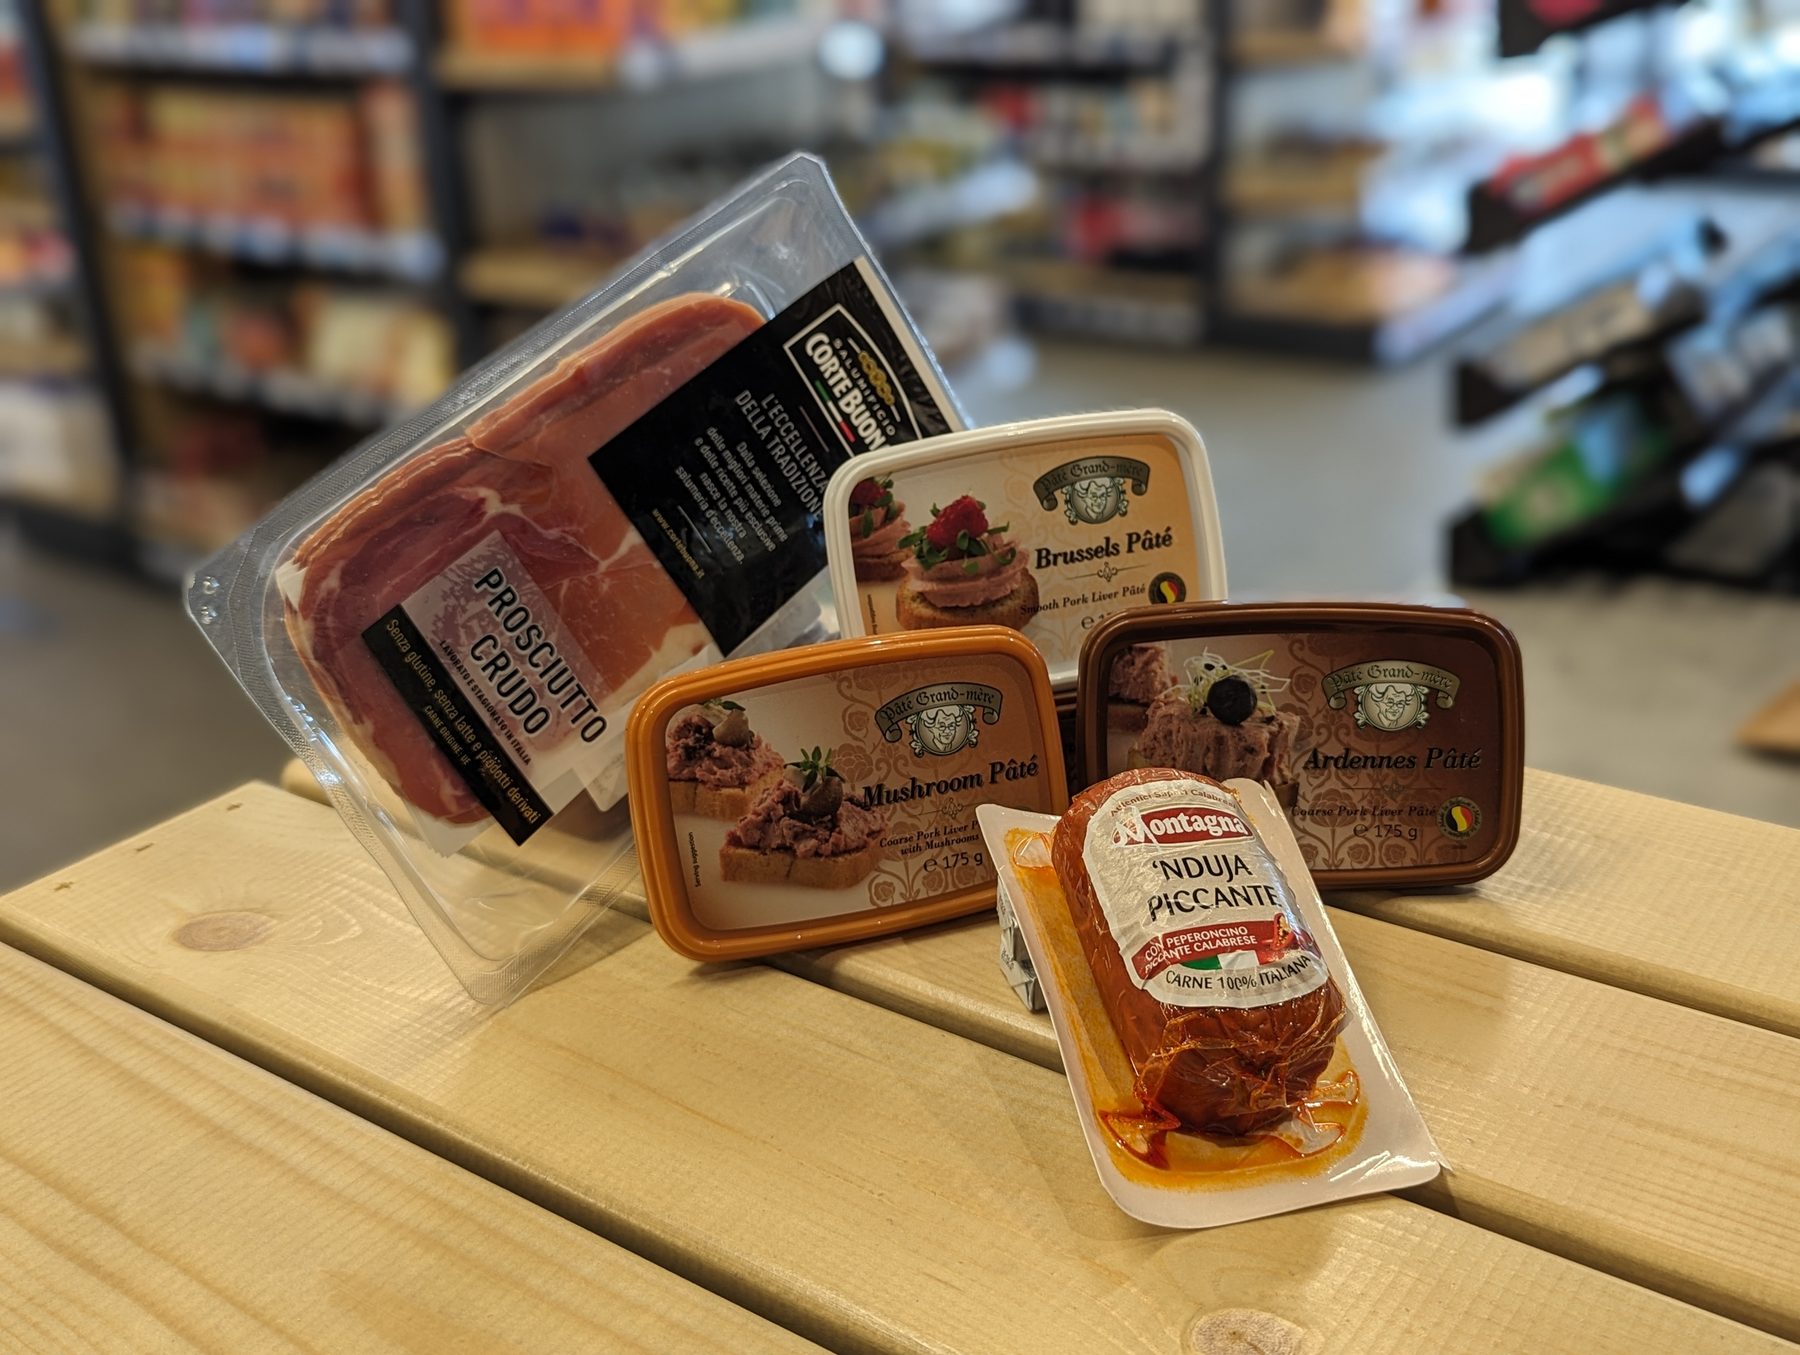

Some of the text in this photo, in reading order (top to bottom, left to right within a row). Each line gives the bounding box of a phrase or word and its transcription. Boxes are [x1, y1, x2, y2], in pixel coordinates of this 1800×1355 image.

[805, 332, 891, 451] CORTEBUON
[833, 338, 896, 436] SALUMIFICIO
[735, 390, 772, 440] DELLA
[676, 465, 709, 511] salumeria
[695, 437, 703, 446] e
[700, 445, 719, 469] delle
[716, 467, 738, 498] ricette
[745, 512, 776, 552] esclusive
[707, 427, 789, 542] delle migliori materie prime
[736, 441, 782, 507] Dalla selezione
[700, 472, 747, 538] nasce la nostra
[1035, 526, 1173, 570] Brussels Pâté
[1020, 599, 1060, 616] Smooth
[1063, 593, 1088, 608] Pork
[1092, 590, 1120, 604] Liver
[1122, 583, 1146, 598] Pâté
[473, 567, 607, 744] PROSCIUTTO
[1331, 664, 1452, 690] Pâté Grand-mère
[440, 640, 532, 767] LAVORATO E STAGIONATO IN ITALIA
[470, 634, 551, 735] CRUDO
[881, 687, 994, 724] Pâté Grand-mère
[386, 619, 542, 824] Senza glutine, senza latte e prodotti derivati
[424, 704, 442, 730] CARNE
[460, 752, 472, 765] UE
[1303, 747, 1482, 770] Ardennes Pâté
[863, 754, 1039, 808] Mushroom Pâté
[1153, 789, 1188, 799] Sapi
[1112, 806, 1248, 851] Montagna
[1291, 805, 1436, 817] Coarse Pork Liver Pâté
[1374, 824, 1402, 838] 175
[1408, 827, 1417, 840] g
[880, 834, 913, 848] Coarse
[917, 829, 941, 842] Pork
[943, 824, 968, 837] Liver
[900, 834, 979, 855] with Mushrooms
[943, 852, 969, 869] 175
[974, 853, 983, 866] g
[1147, 885, 1282, 922] PICCANTE
[1144, 935, 1257, 974] PICCANTE CALABRESE
[1145, 926, 1248, 961] CON PEPERONCINO
[1166, 955, 1311, 990] CARNE 100% ITALIANA
